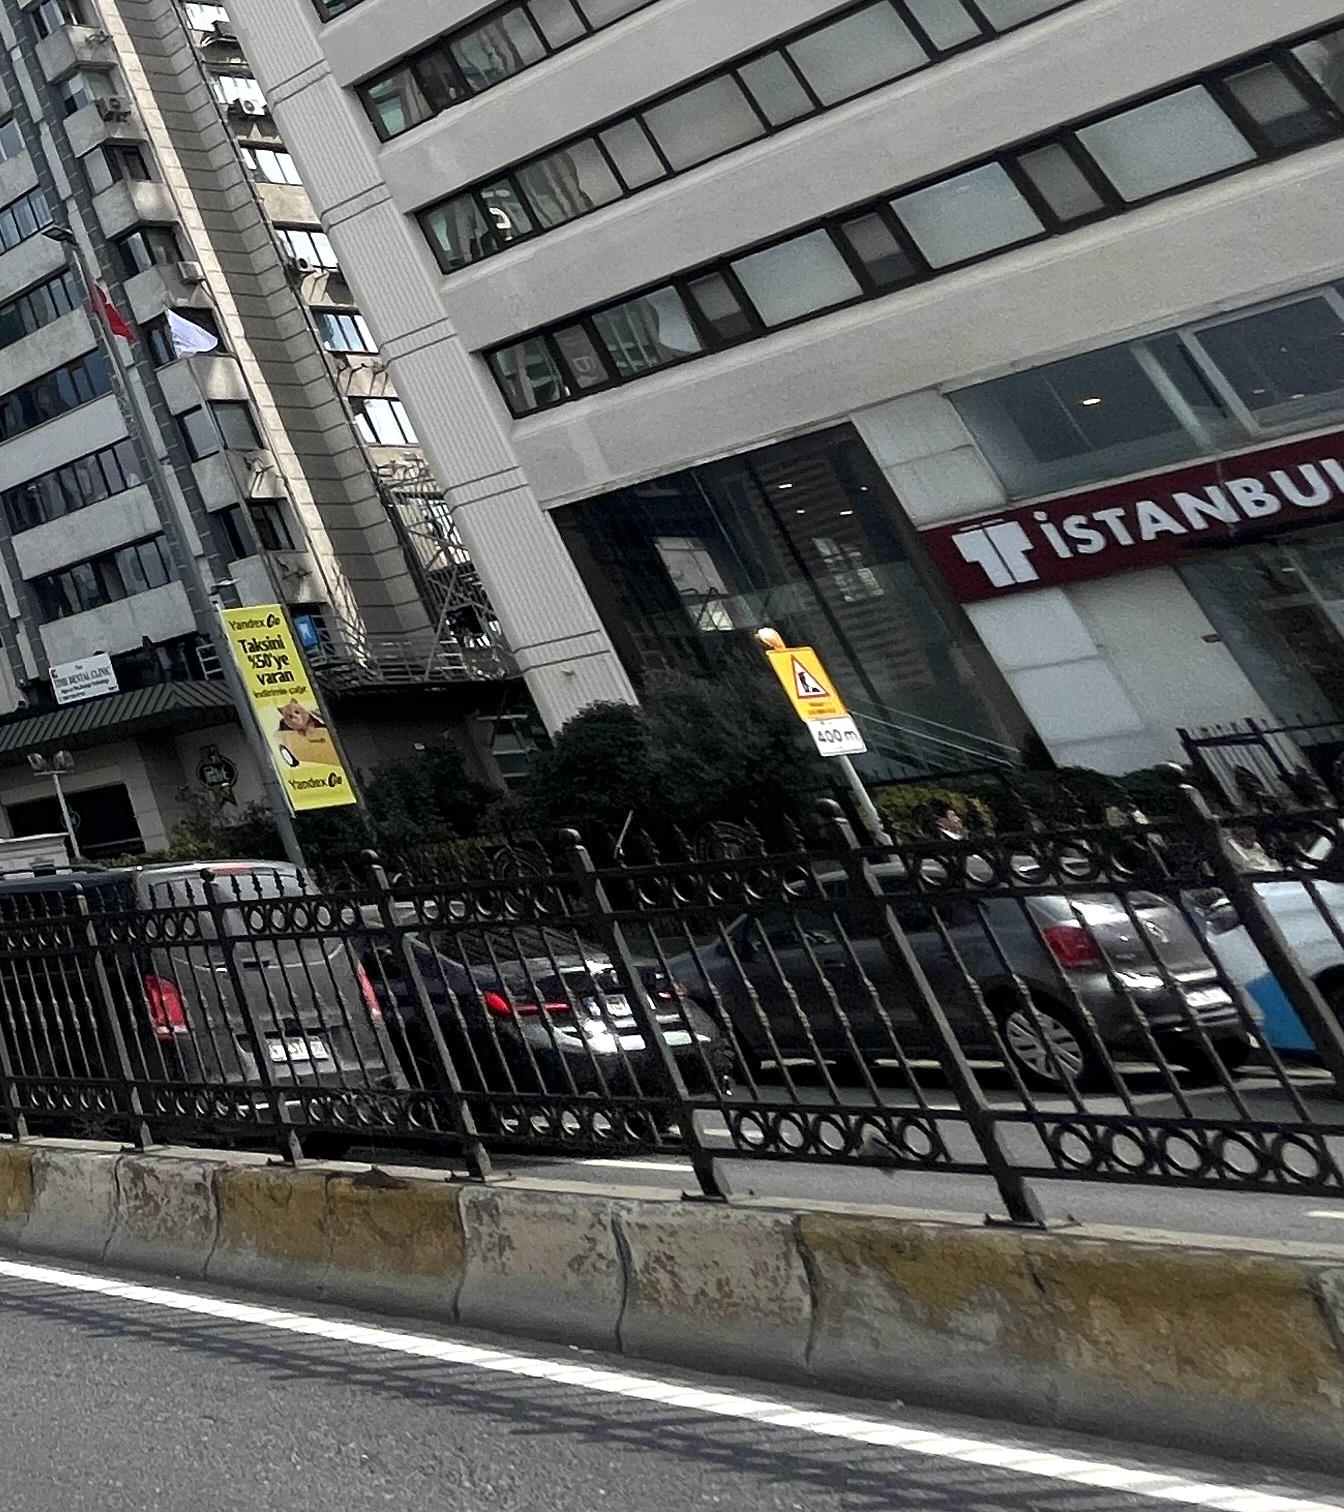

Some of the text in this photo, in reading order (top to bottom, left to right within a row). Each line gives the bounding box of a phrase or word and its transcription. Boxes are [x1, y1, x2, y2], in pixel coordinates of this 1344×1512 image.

[228, 619, 266, 631] Yandex
[237, 633, 286, 654] Taksini
[256, 670, 295, 686] varan
[817, 729, 860, 744] 400 m
[289, 778, 328, 791] Yandex
